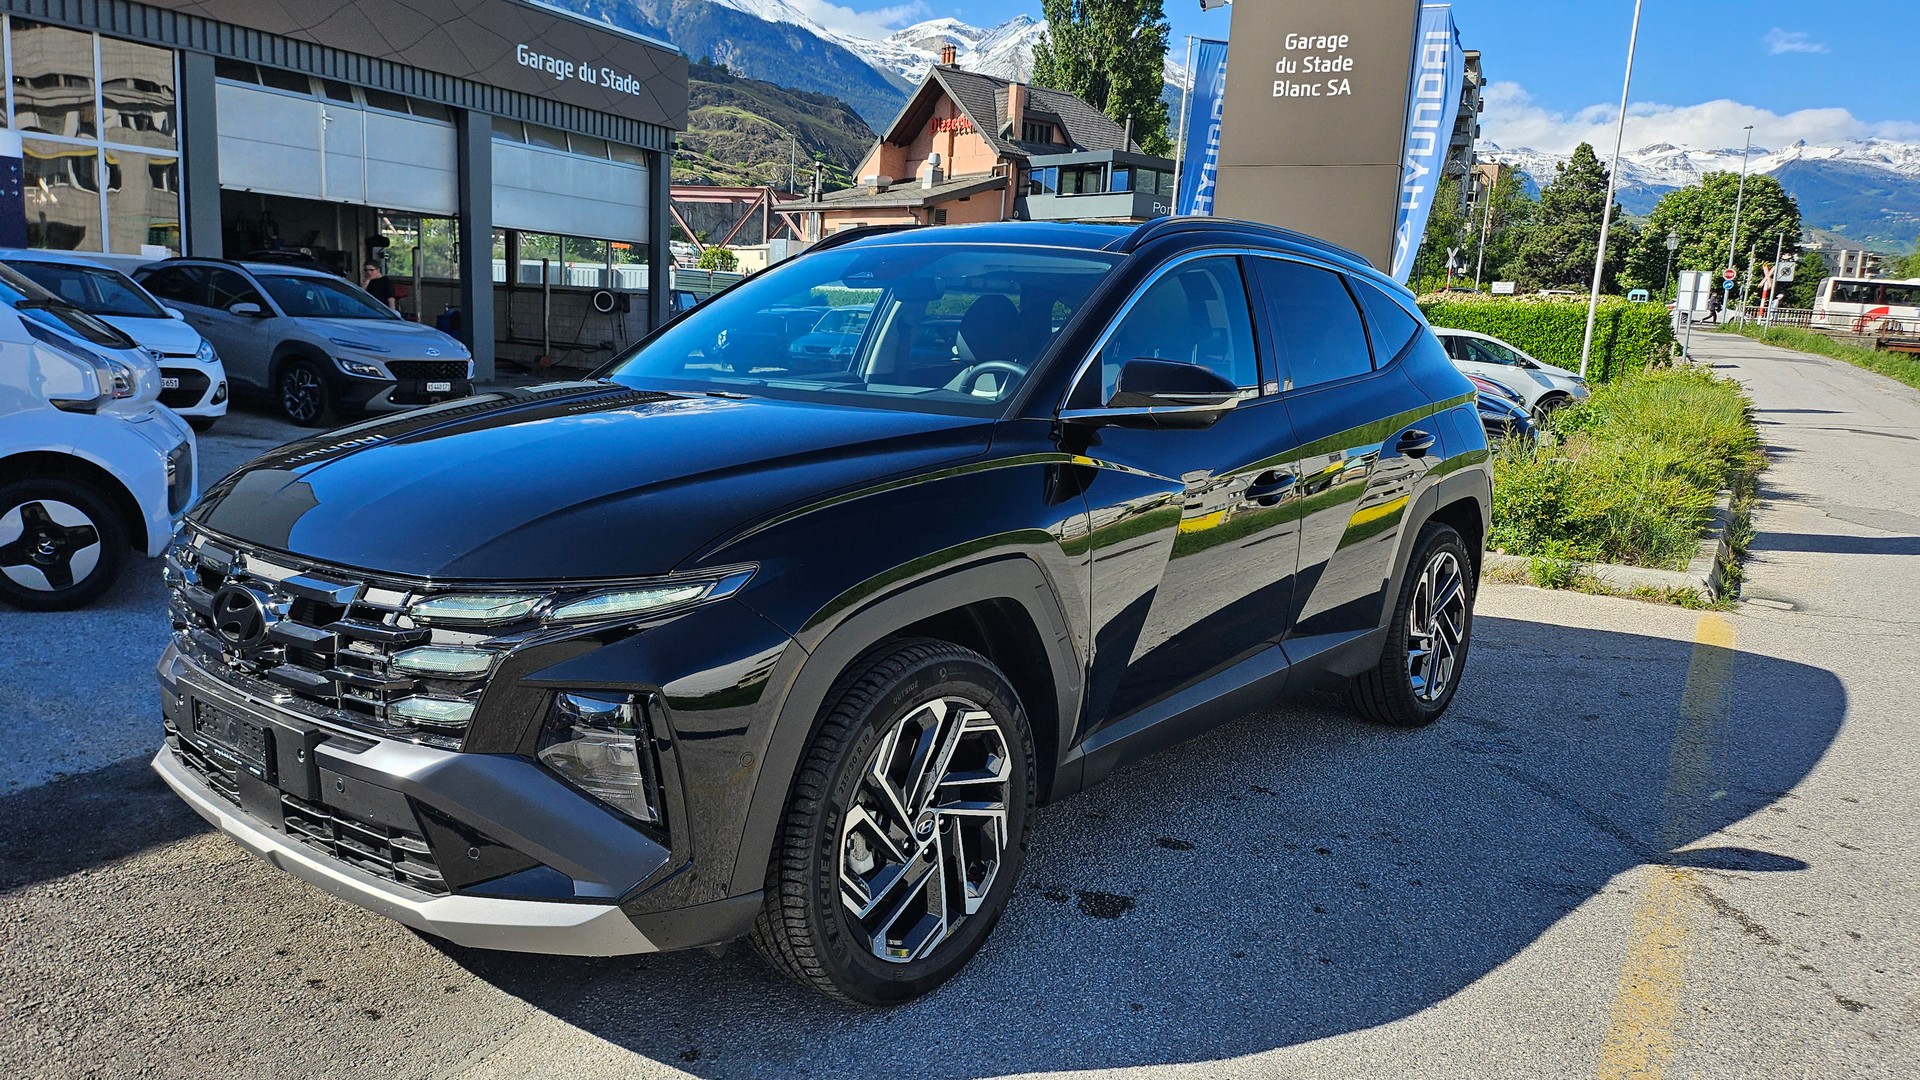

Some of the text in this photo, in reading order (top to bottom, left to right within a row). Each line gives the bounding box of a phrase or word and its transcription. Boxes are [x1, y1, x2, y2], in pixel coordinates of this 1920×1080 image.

[1285, 33, 1349, 53] Garage
[517, 44, 640, 96] Garage du Stade
[1276, 55, 1354, 74] du Stade
[1273, 78, 1352, 97] Blanc SA
[1402, 32, 1451, 210] HYUNDAI
[893, 680, 919, 704] OUTSIDE
[820, 810, 838, 936] MICHELIN
